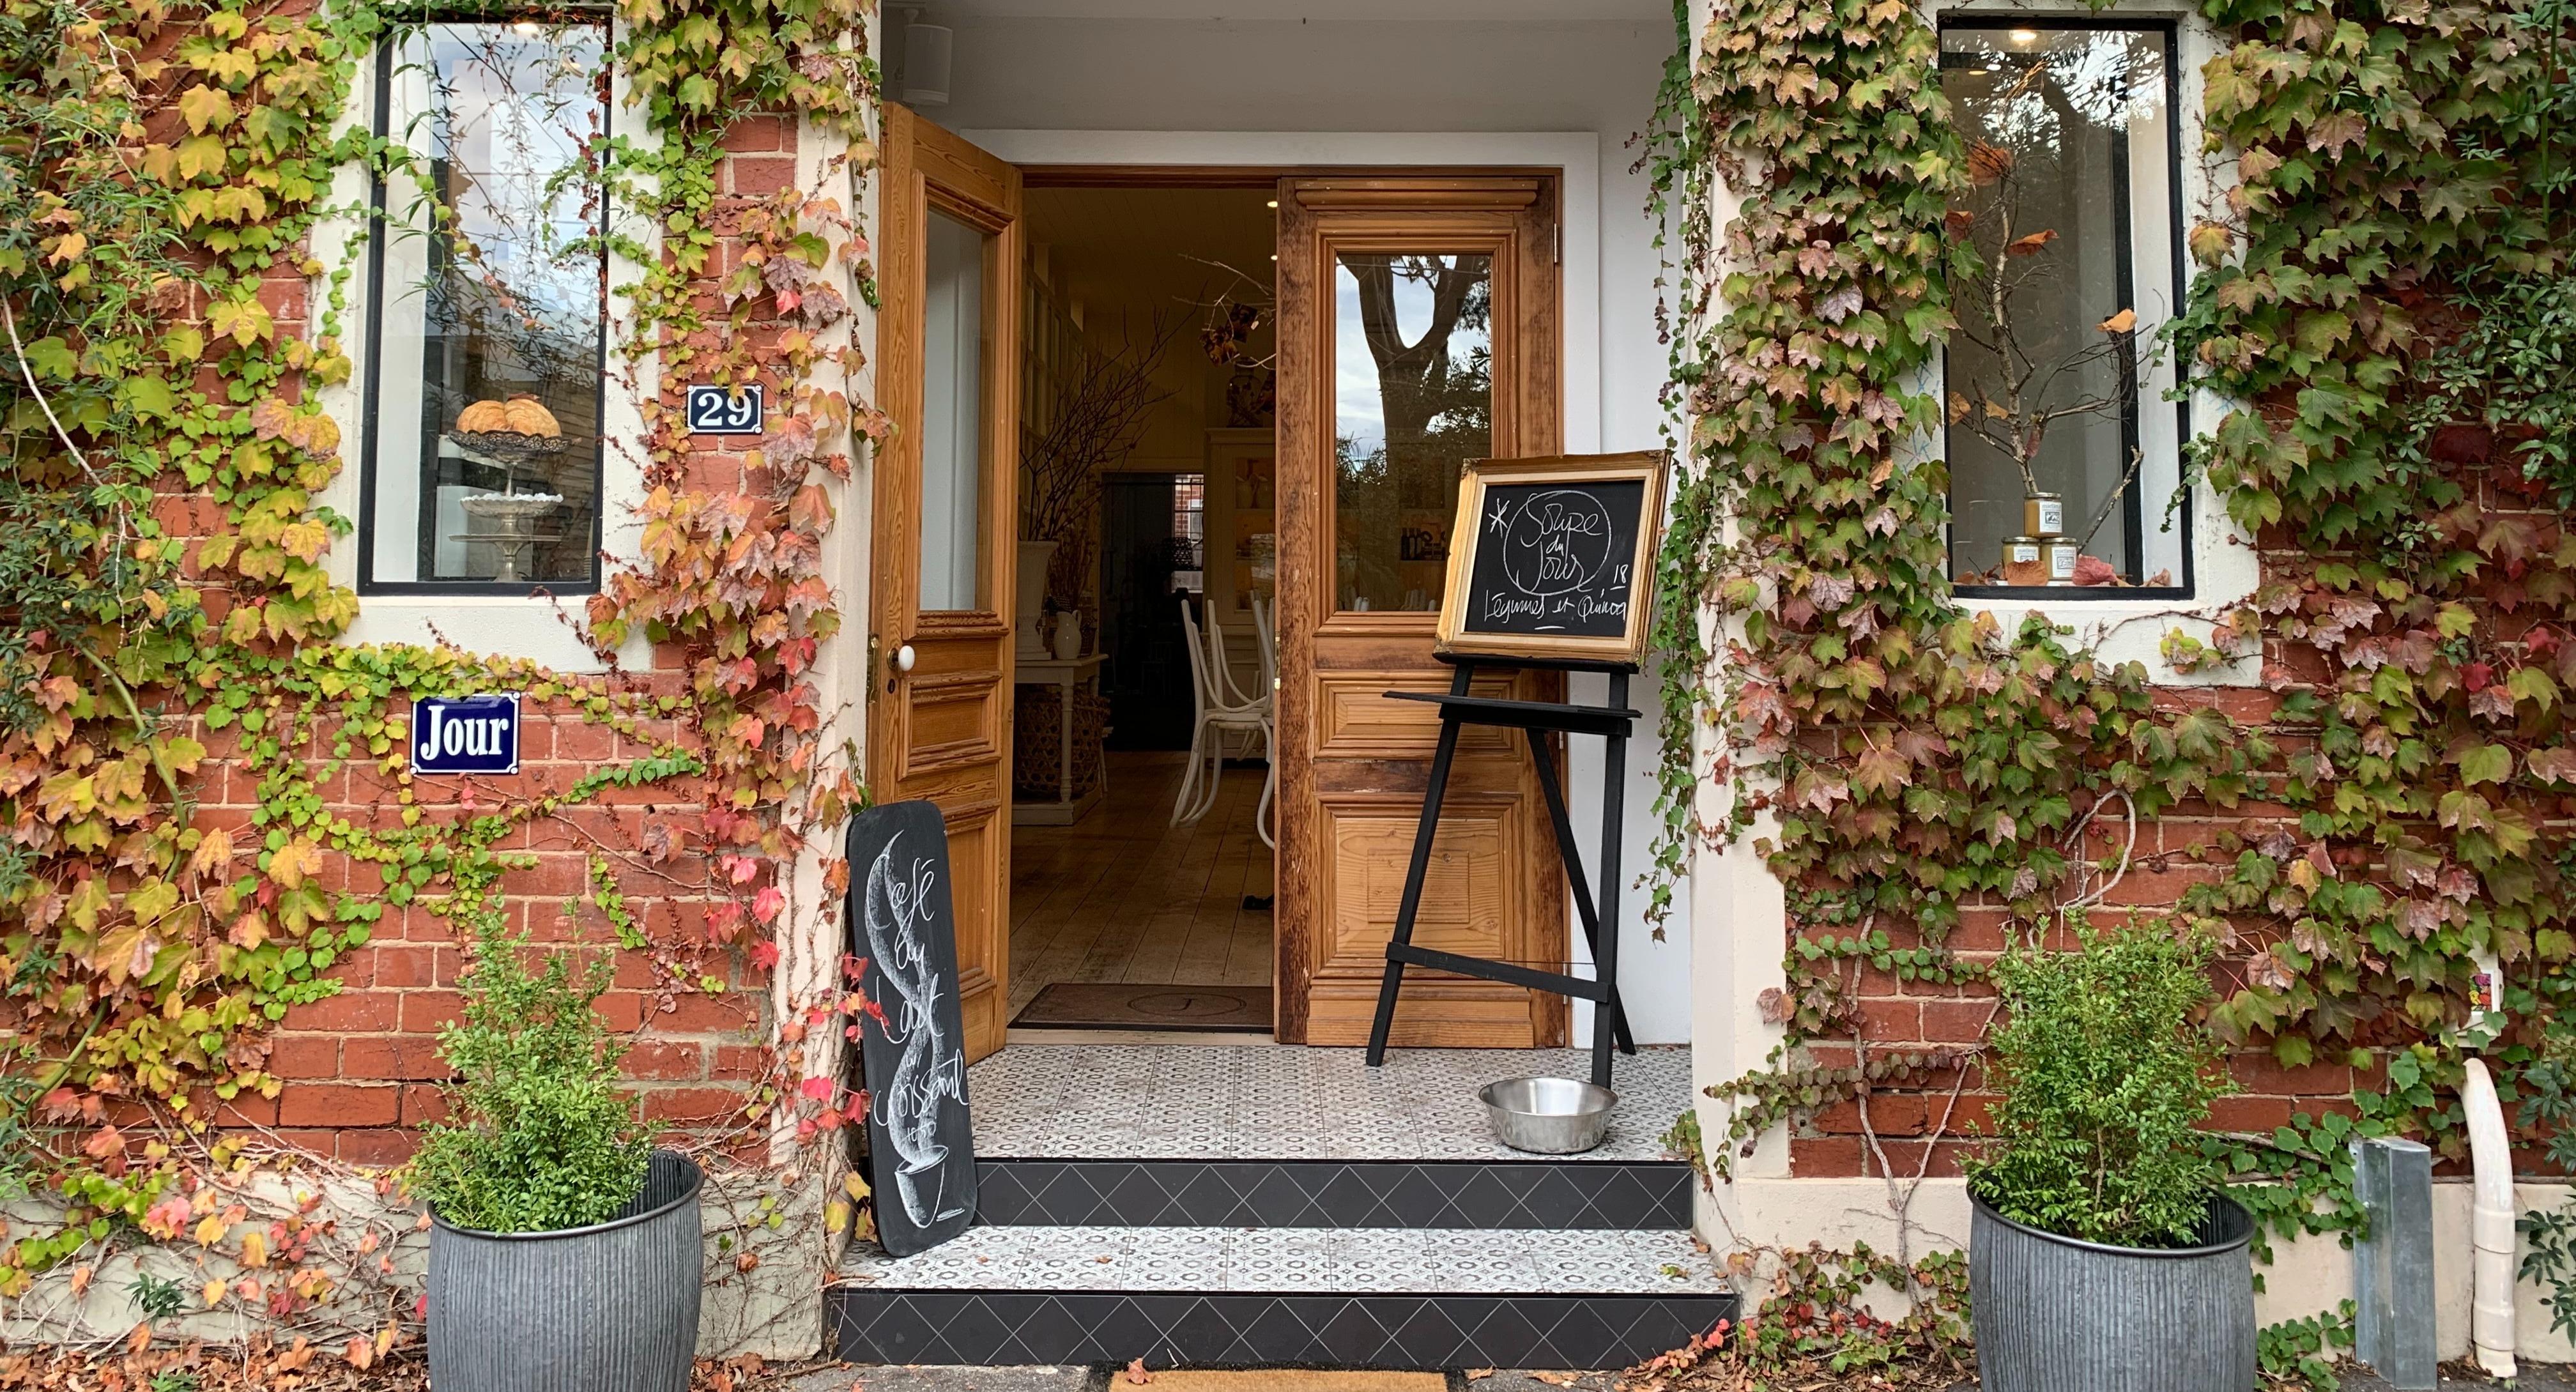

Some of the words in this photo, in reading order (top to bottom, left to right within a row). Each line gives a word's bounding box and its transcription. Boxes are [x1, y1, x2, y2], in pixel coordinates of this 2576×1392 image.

[698, 392, 752, 426] 29
[1521, 493, 1603, 563] Soupe
[1545, 534, 1564, 556] du
[1516, 541, 1593, 592] Jour
[1613, 563, 1629, 584] 18
[1552, 597, 1575, 613] et
[1577, 588, 1627, 623] Quinoa
[420, 705, 509, 761] Jour
[866, 854, 935, 952] Café
[896, 940, 926, 975] au
